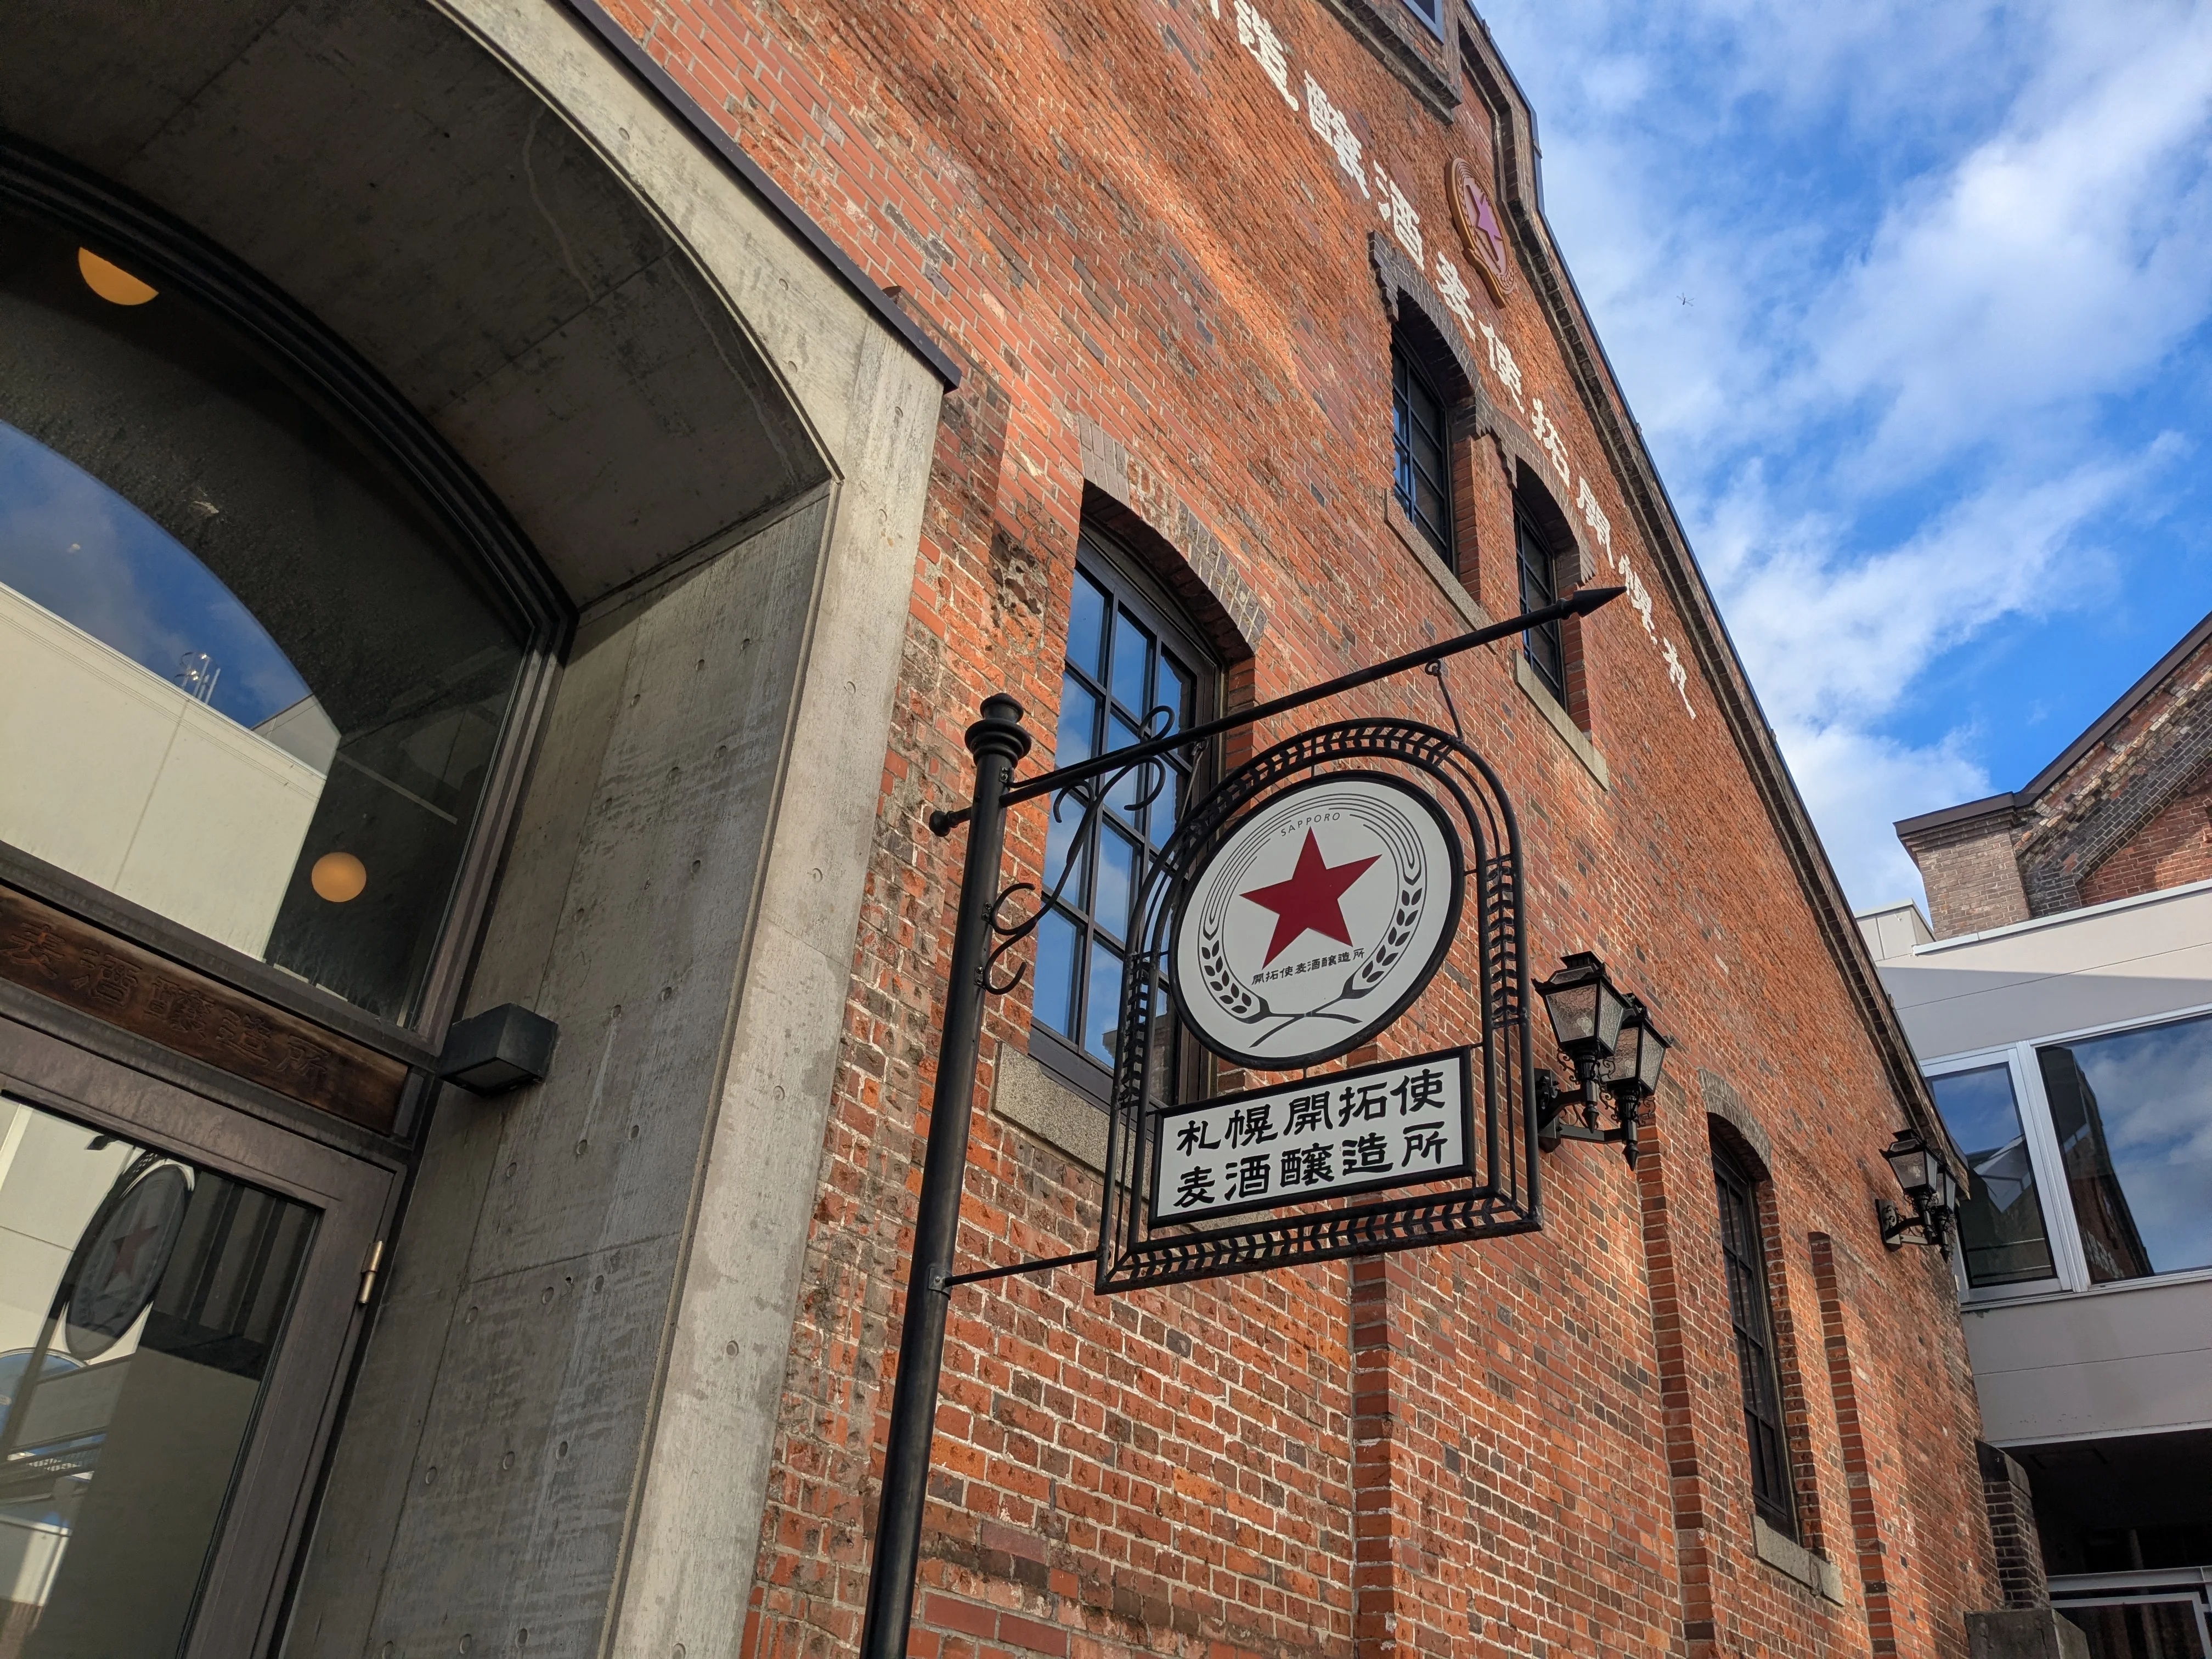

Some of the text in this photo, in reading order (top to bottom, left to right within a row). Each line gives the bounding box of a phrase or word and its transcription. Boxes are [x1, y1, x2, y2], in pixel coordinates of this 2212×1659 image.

[1280, 812, 1340, 837] SAPPORO
[1251, 947, 1365, 986] 開拓使麦酒醸造所
[1177, 1068, 1446, 1156] 札幌開拓使
[1173, 1121, 1448, 1208] 麦酒醸造所
